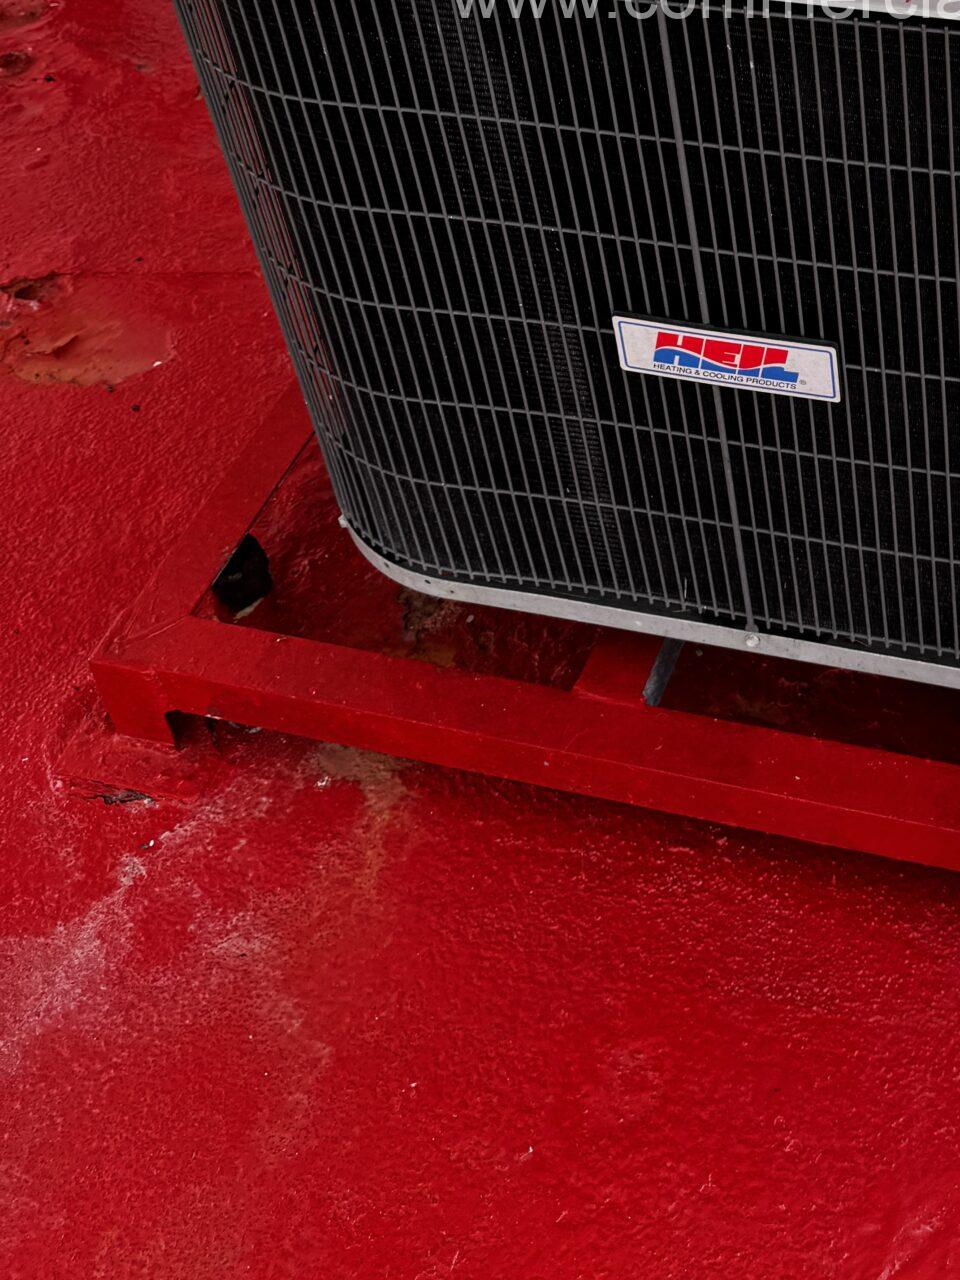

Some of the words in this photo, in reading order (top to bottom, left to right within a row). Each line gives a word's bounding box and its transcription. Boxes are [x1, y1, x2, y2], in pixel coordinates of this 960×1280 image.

[653, 331, 800, 384] HEIL
[653, 363, 693, 375] HEATING
[702, 370, 744, 383] COOLING
[745, 377, 797, 390] PRODUCTS
